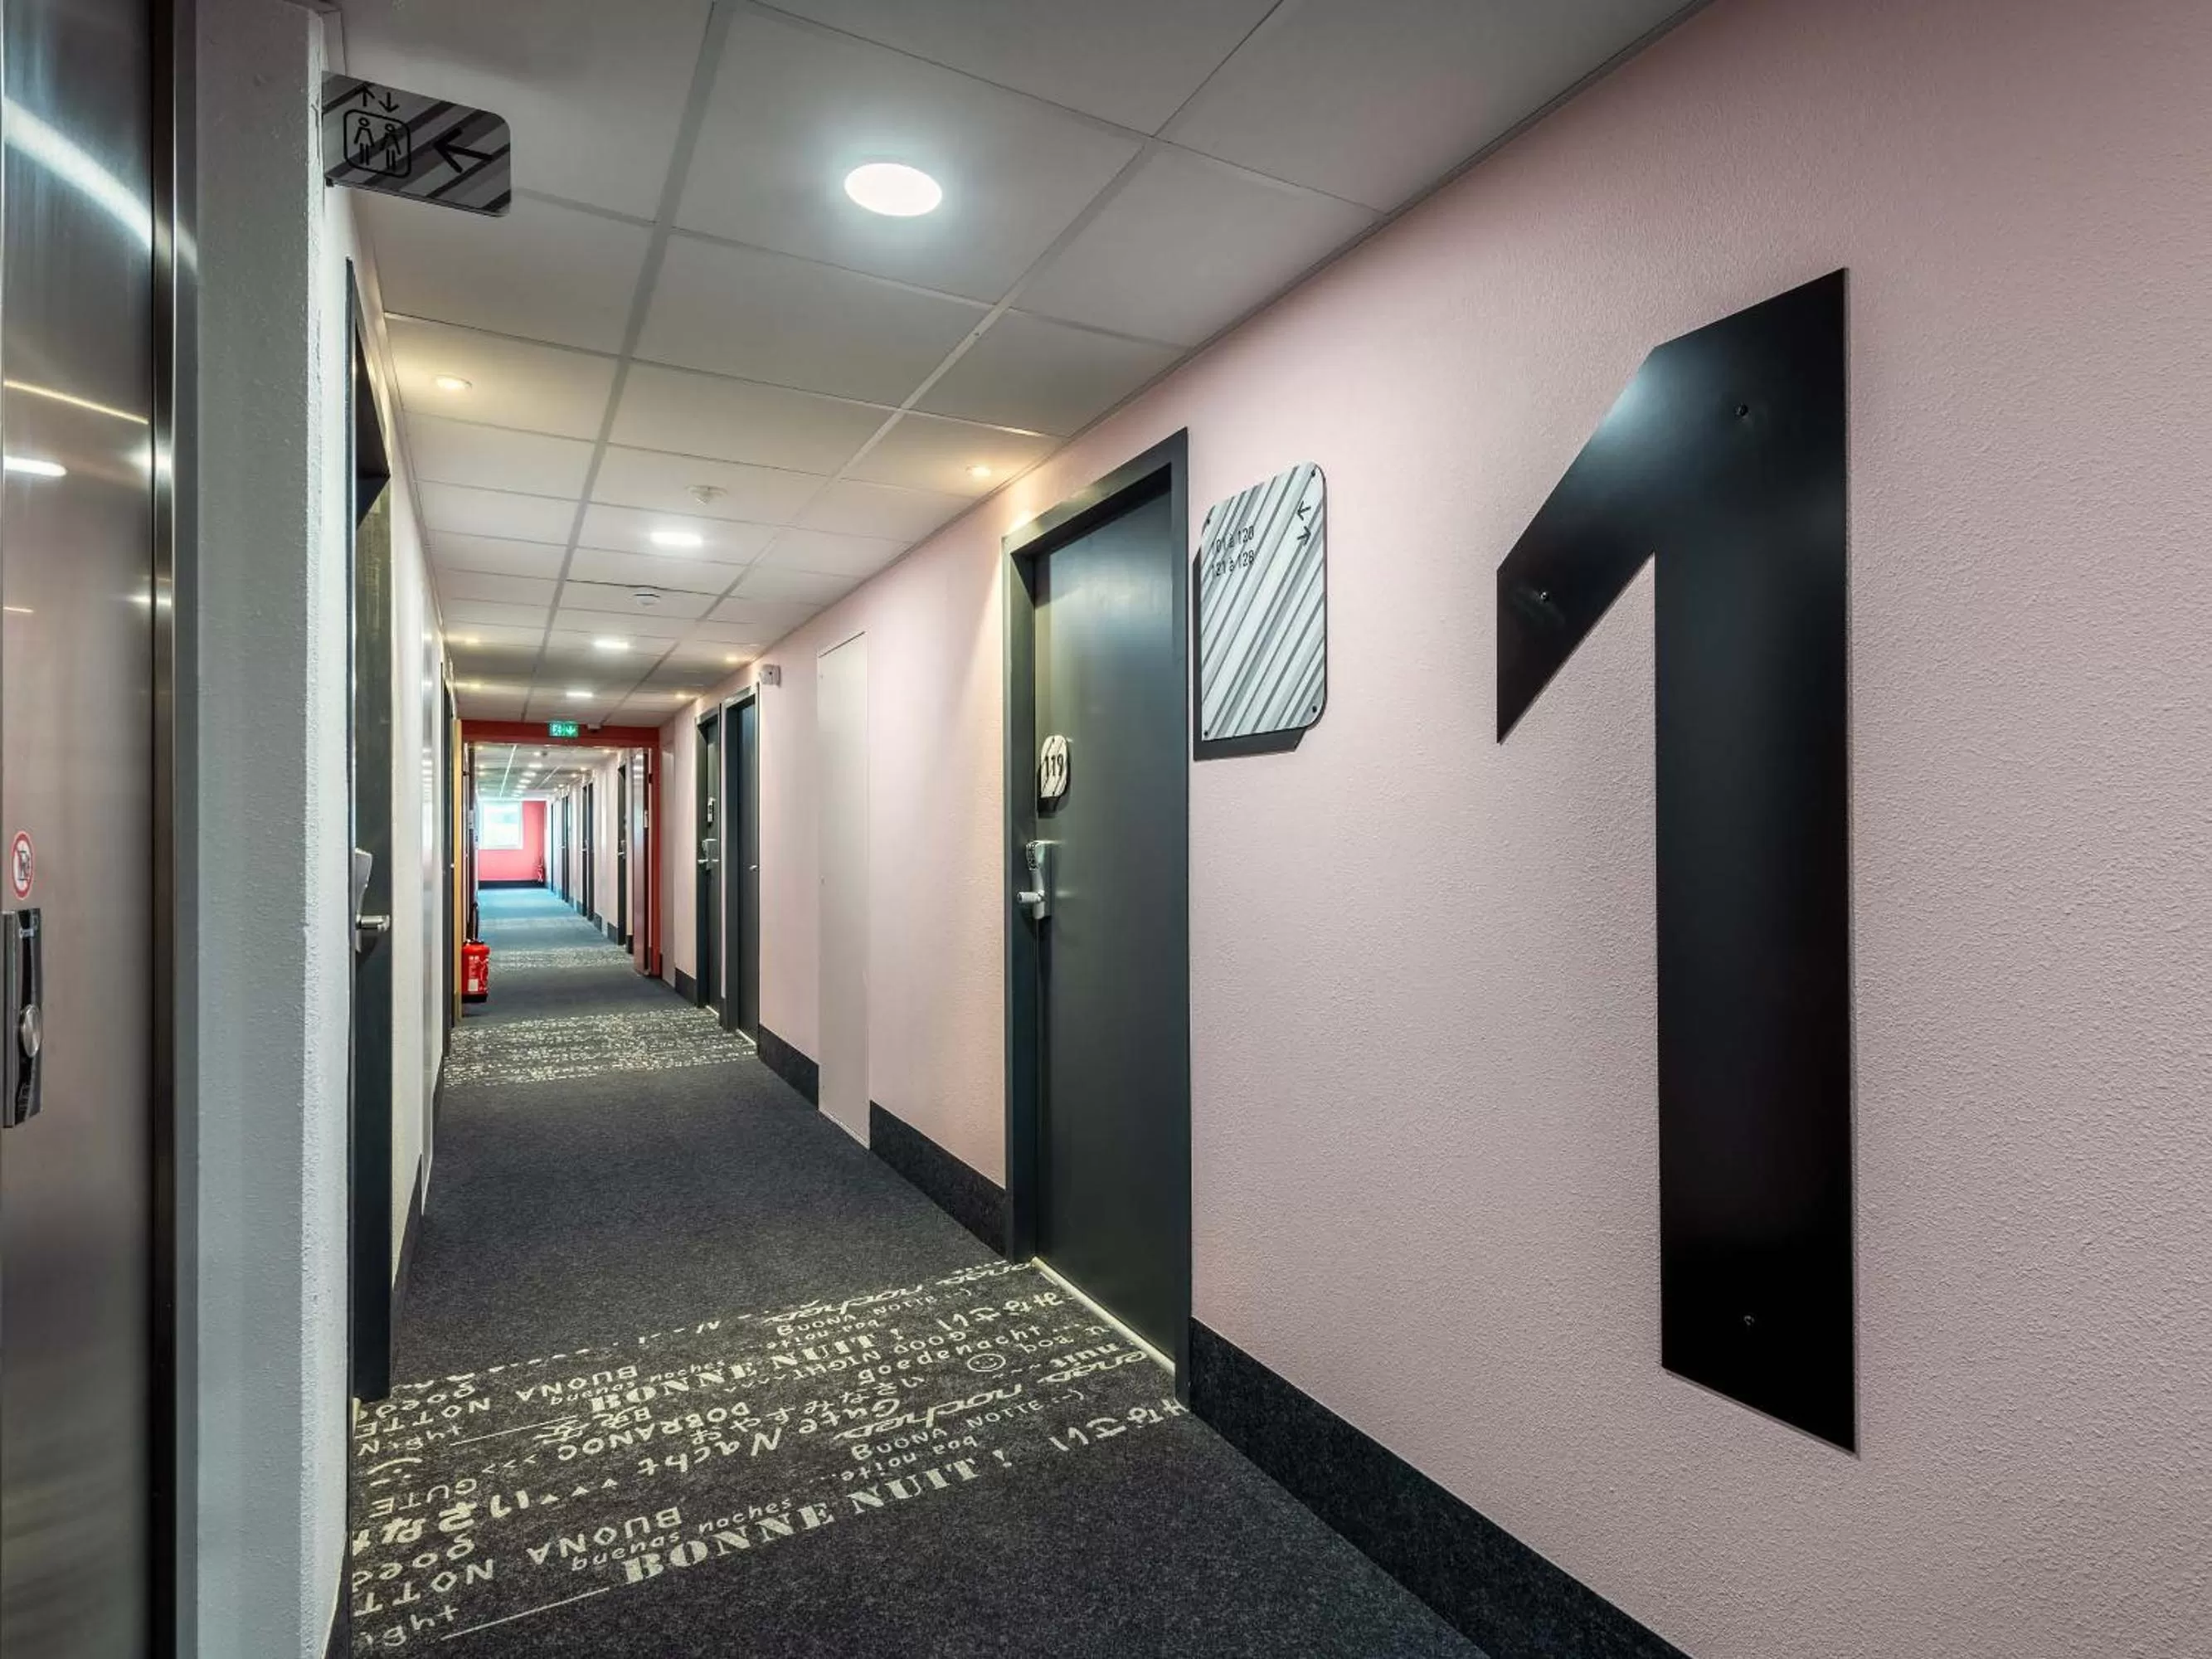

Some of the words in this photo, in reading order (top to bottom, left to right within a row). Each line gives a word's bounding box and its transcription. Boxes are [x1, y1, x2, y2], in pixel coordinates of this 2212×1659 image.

[1044, 752, 1064, 778] 119
[1496, 267, 1857, 1454] 1
[894, 1331, 965, 1353] GOOD
[516, 1366, 637, 1401] BUONA
[591, 1362, 756, 1412] BONNE
[771, 1334, 874, 1370] NUIT
[355, 1398, 489, 1438] NOTTE
[558, 1402, 750, 1460] DOBRANOC
[691, 1377, 924, 1445] おやすみなさい
[799, 1399, 899, 1433] Gute
[639, 1422, 785, 1475] Nacht
[369, 1479, 476, 1517] GUTE
[622, 1503, 834, 1584] BONNE
[847, 1458, 978, 1514] NUIT
[527, 1507, 682, 1564] BUONA
[572, 1532, 679, 1571] buenas
[699, 1498, 790, 1534] noches
